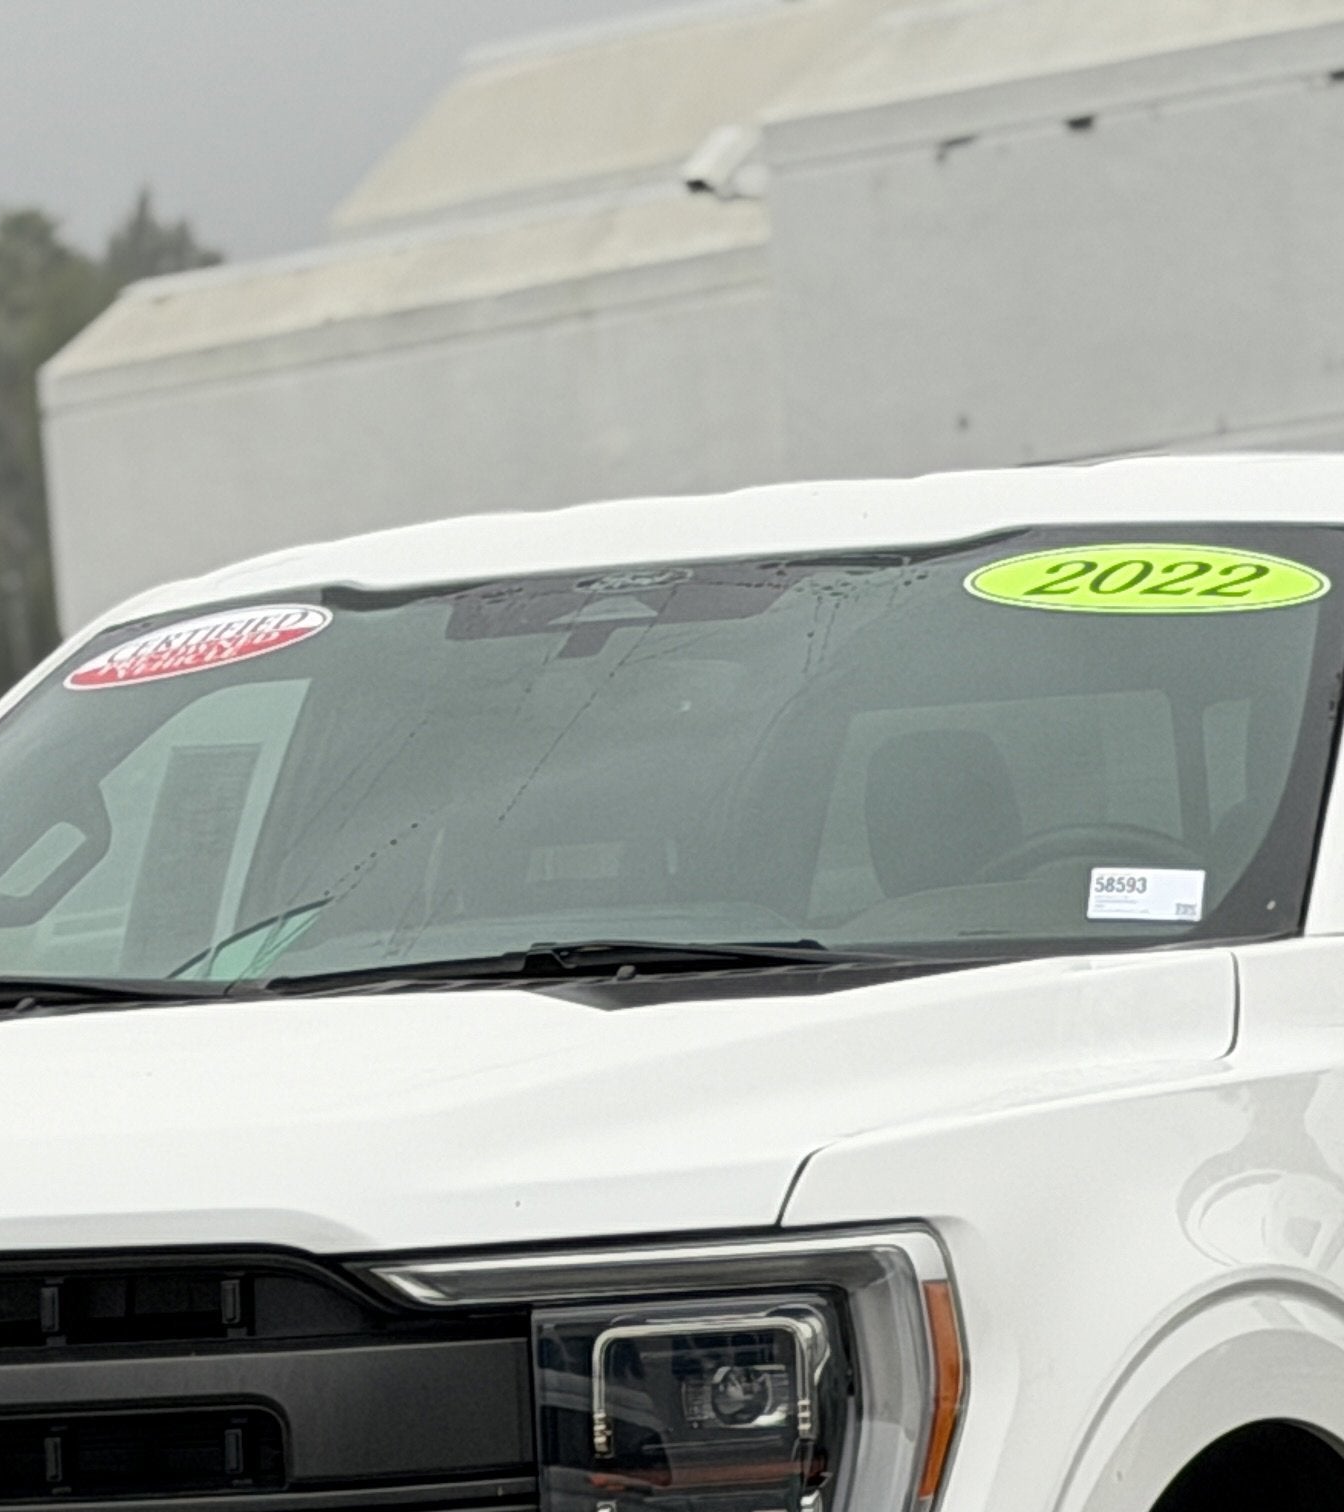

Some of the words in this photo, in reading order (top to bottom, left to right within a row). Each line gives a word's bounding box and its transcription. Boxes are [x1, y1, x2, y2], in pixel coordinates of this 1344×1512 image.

[1024, 559, 1271, 598] 2022
[108, 611, 310, 664] CERTIFIED
[1094, 876, 1148, 894] 58593
